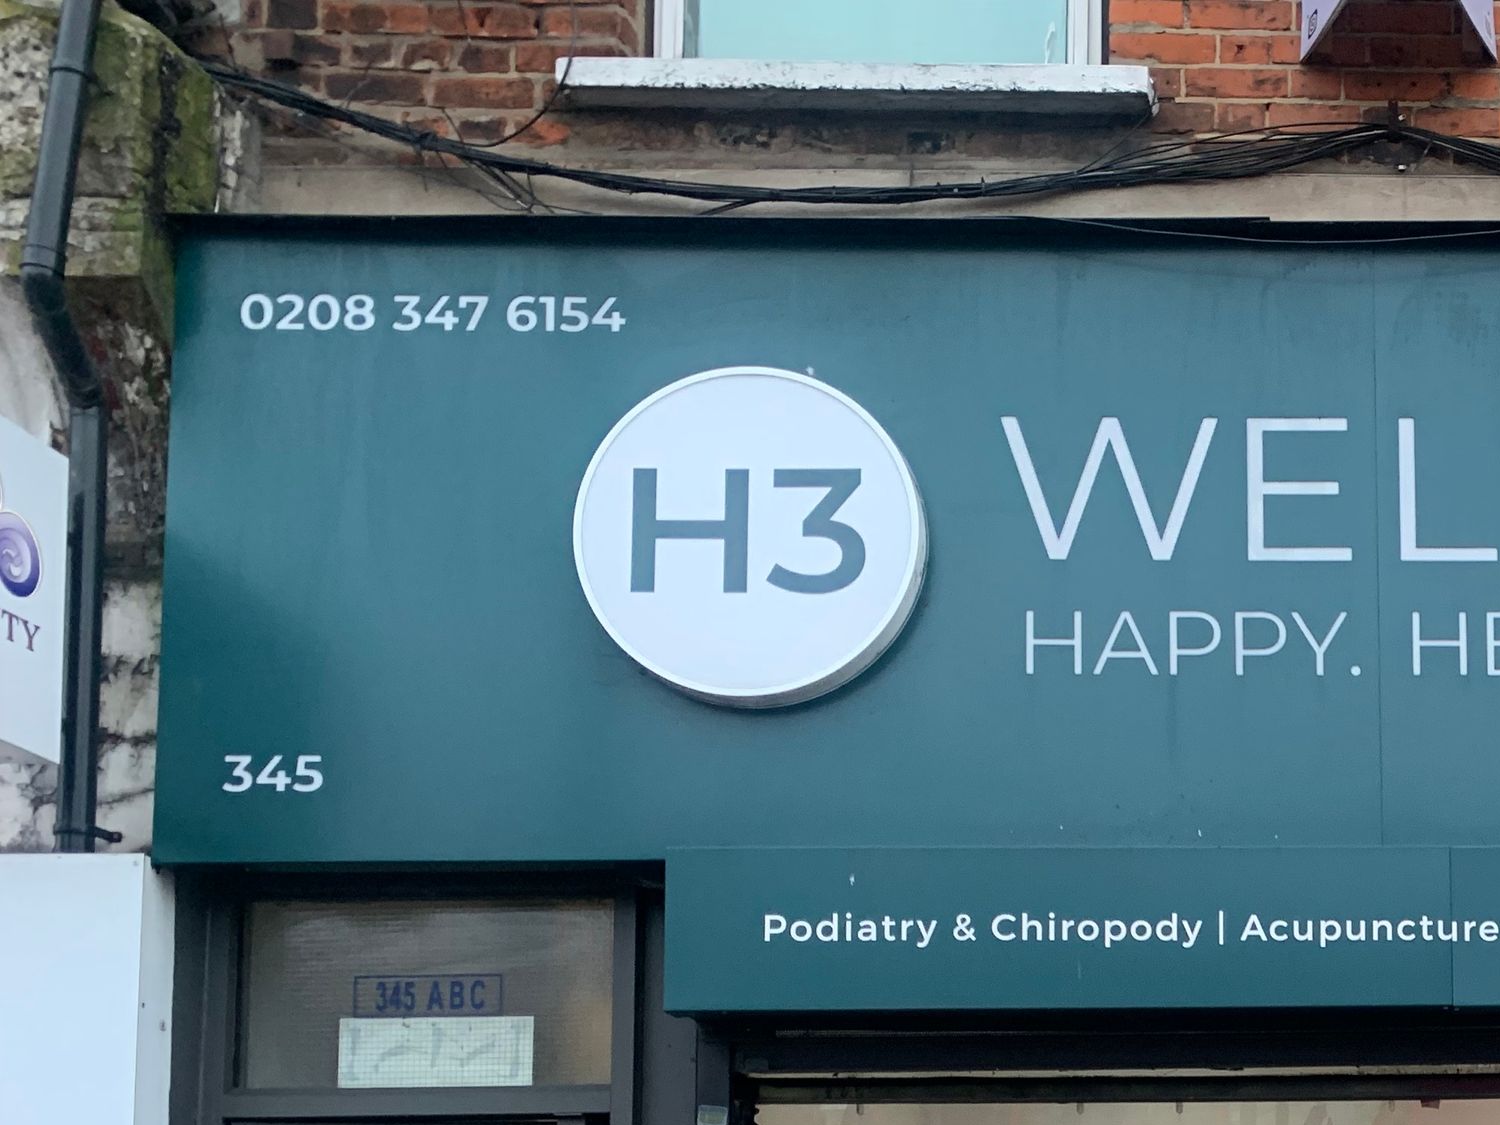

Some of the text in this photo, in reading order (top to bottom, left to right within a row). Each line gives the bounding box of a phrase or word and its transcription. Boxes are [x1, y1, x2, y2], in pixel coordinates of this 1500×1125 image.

[240, 294, 627, 333] 0208 347 6154
[630, 467, 866, 595] H3
[1025, 610, 1362, 677] HAPPY.
[222, 754, 324, 793] 345
[764, 912, 938, 948] Podiatry
[952, 913, 977, 942] &
[991, 911, 1203, 949] Chiropody
[1240, 914, 1499, 948] Acupuncture
[375, 980, 416, 1011] 345
